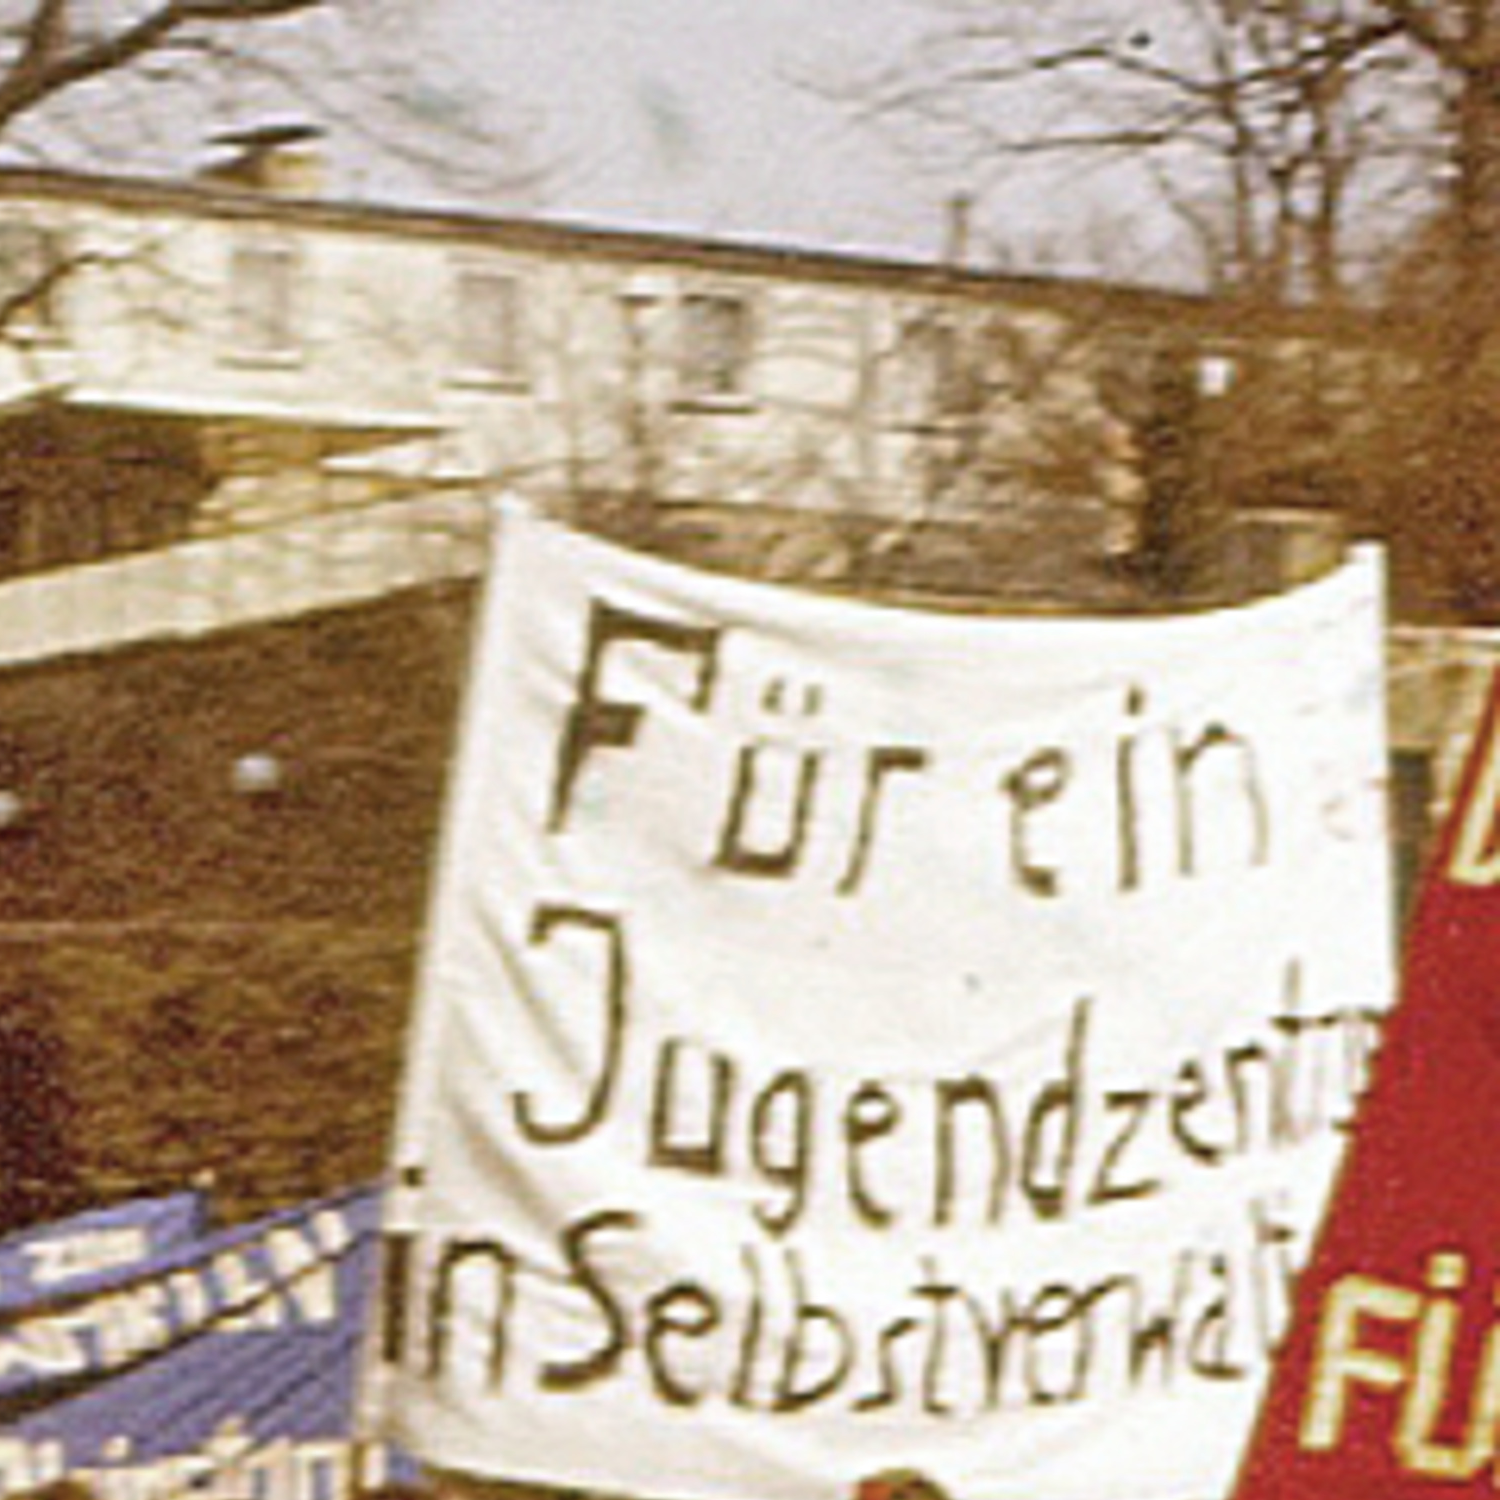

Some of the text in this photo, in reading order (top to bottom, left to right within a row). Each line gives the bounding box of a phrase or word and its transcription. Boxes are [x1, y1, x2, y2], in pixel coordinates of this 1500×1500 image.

[546, 597, 928, 897] Für
[1000, 683, 1270, 897] ein
[1297, 1250, 1500, 1486] FÜ
